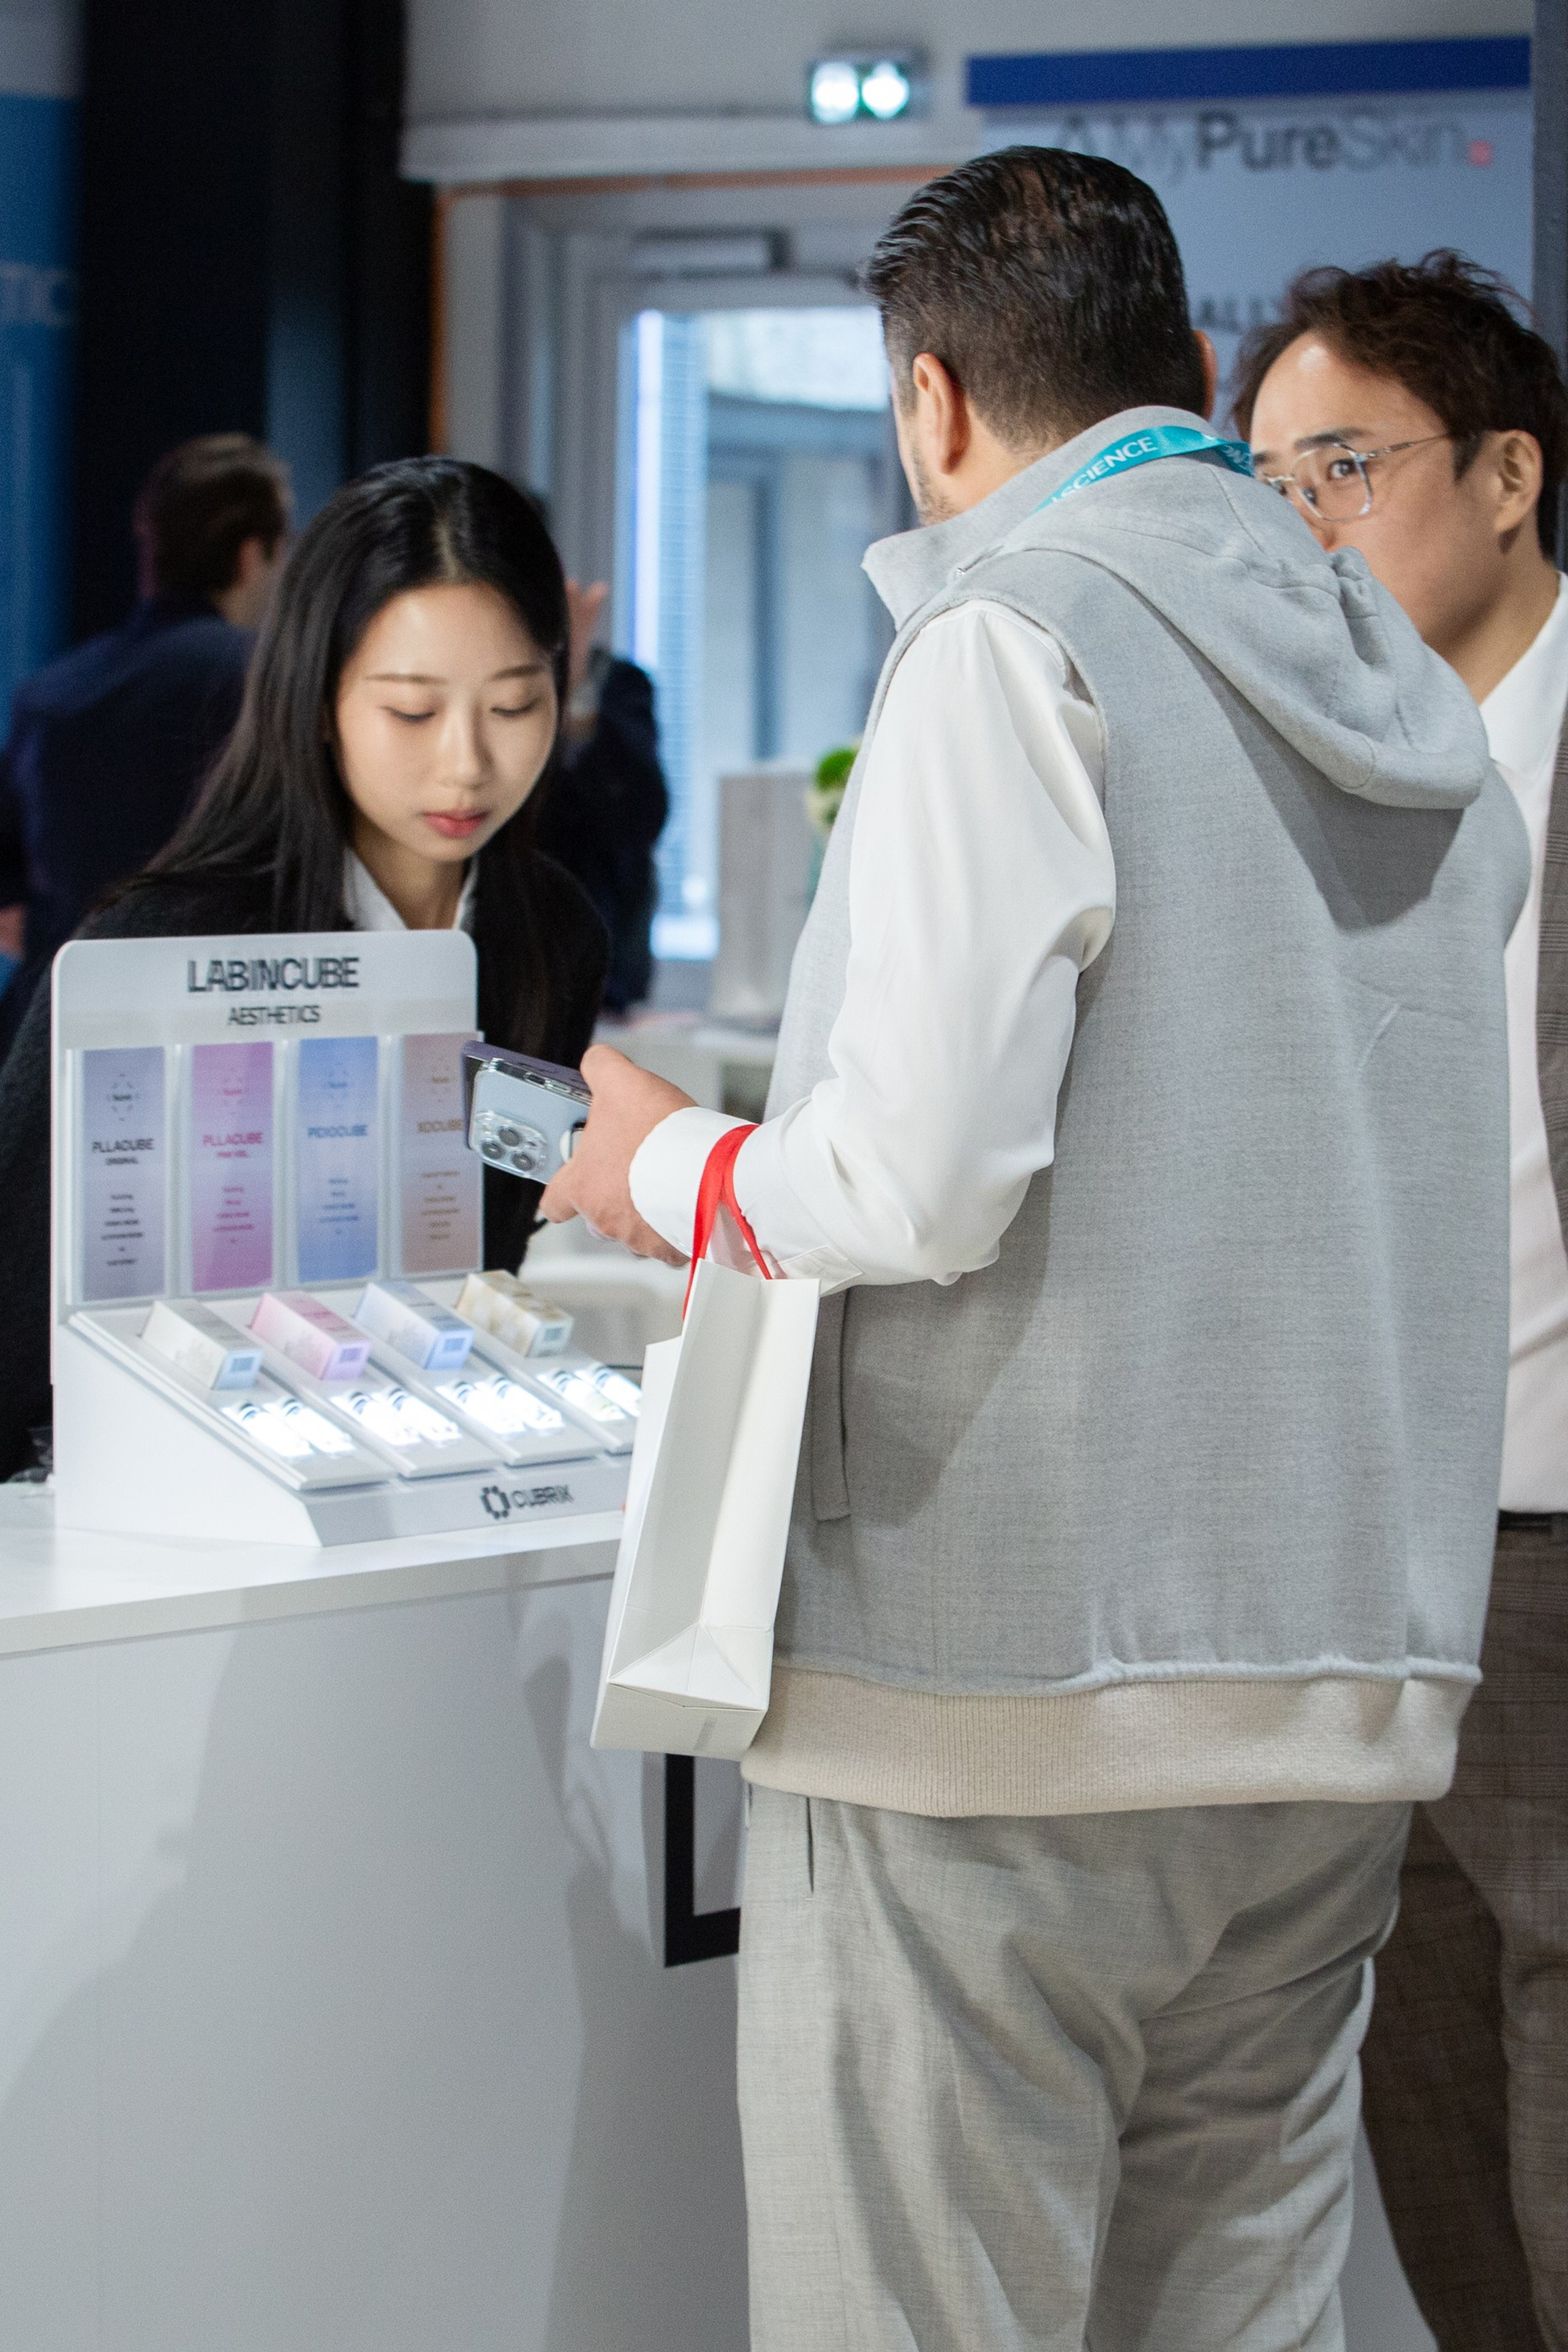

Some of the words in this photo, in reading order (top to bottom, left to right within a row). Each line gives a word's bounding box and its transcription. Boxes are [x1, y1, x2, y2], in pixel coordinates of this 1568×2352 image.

[187, 957, 360, 992] LABINCUBE
[227, 1005, 320, 1025] AESTHETICS
[92, 1138, 154, 1153] PLLACUBE
[511, 1485, 574, 1509] CUBRIX
